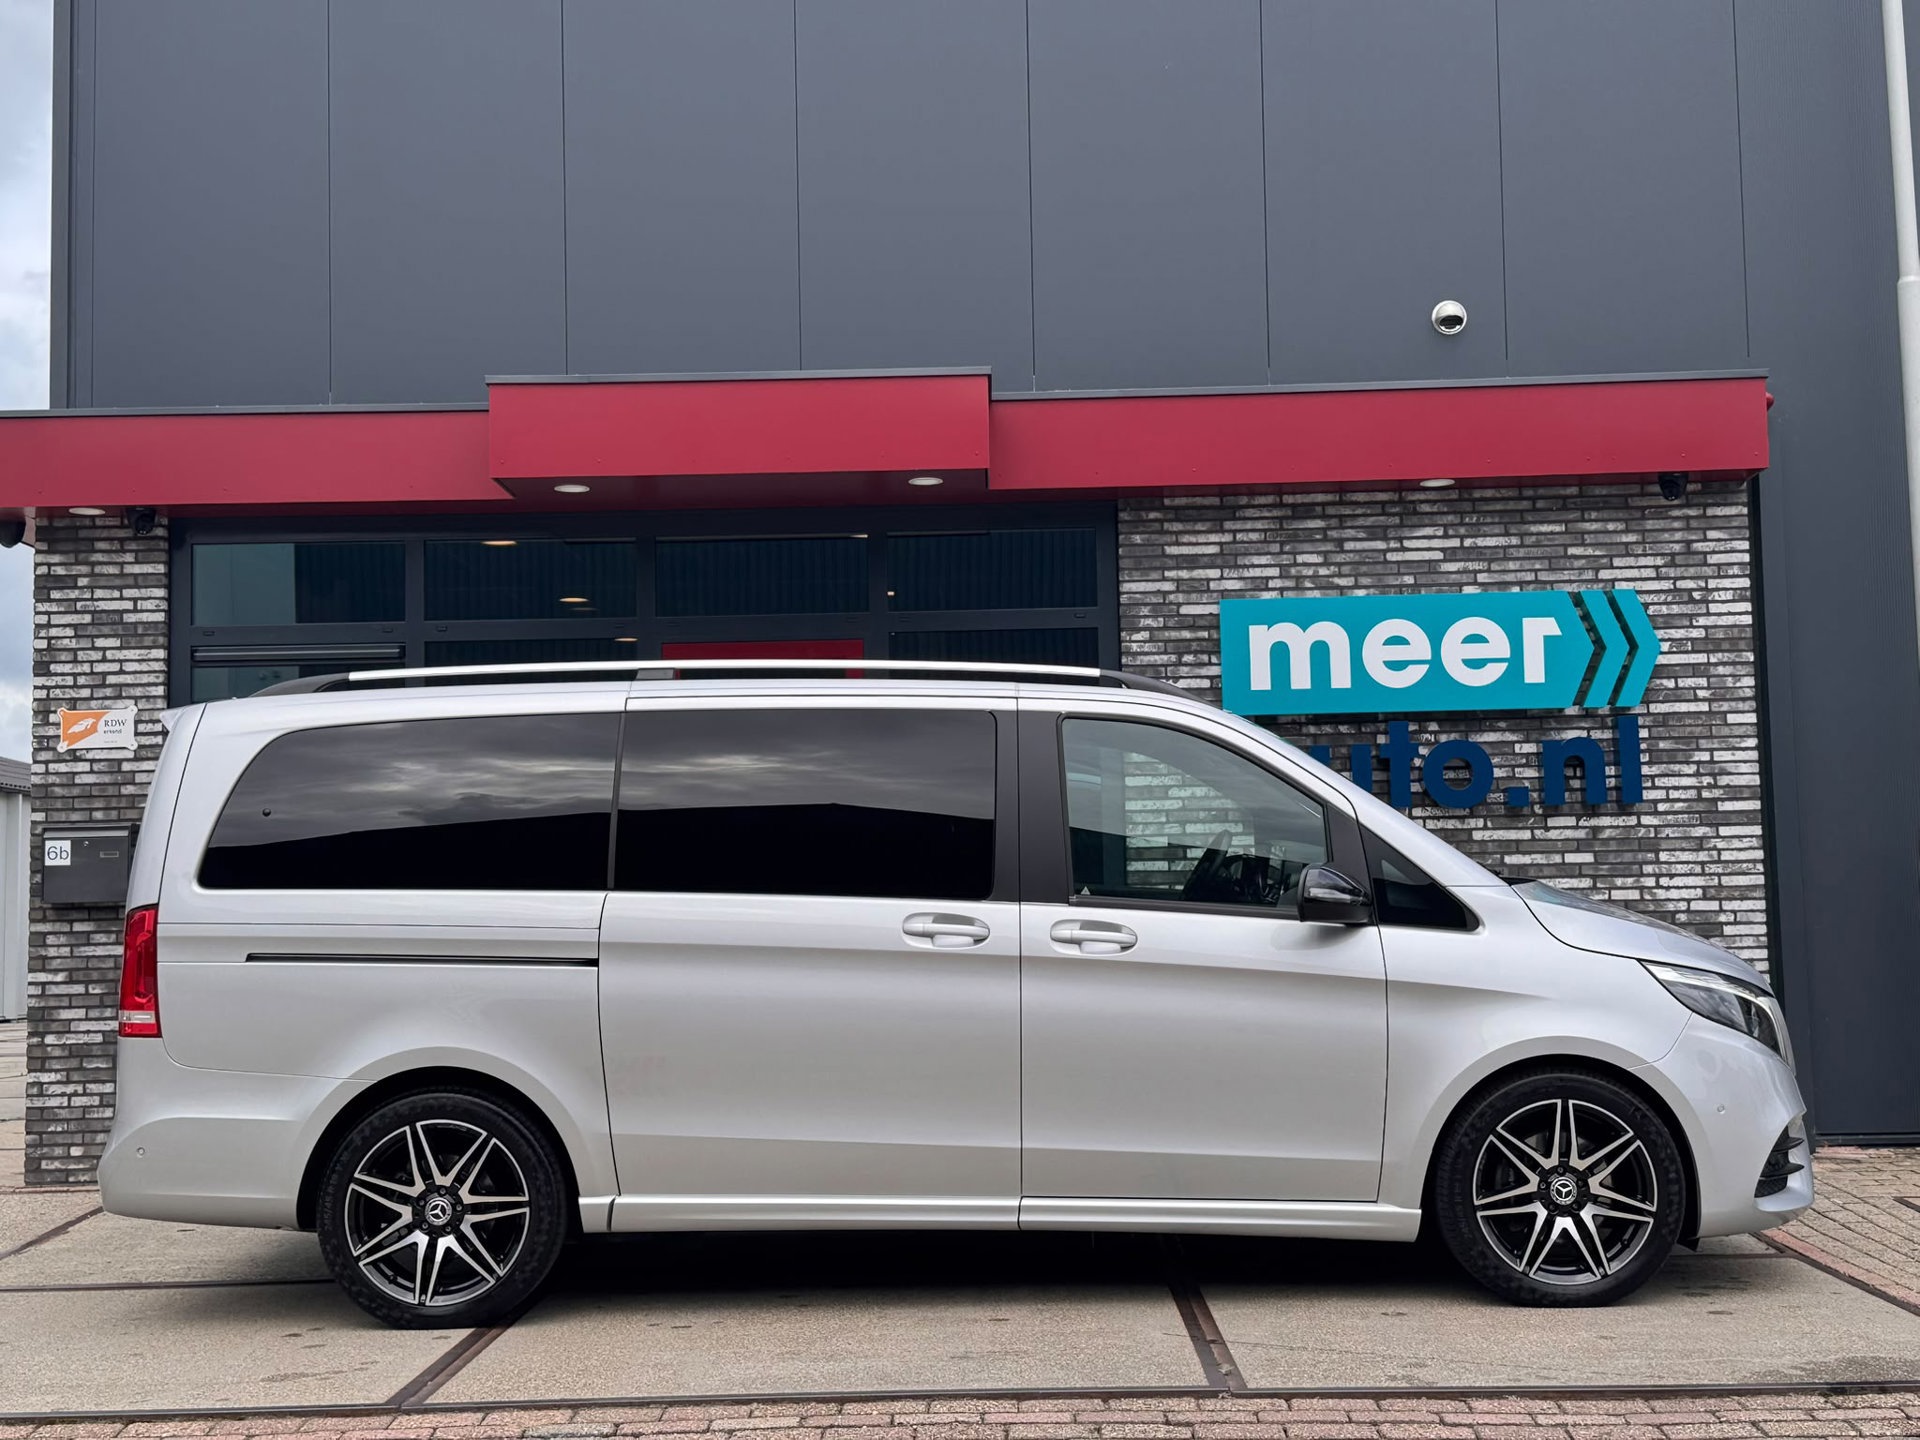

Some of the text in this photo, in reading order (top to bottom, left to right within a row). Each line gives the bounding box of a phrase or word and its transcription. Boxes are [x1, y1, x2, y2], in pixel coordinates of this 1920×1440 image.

[1248, 616, 1563, 691] meer
[104, 719, 127, 727] RDW
[47, 846, 69, 860] 6b
